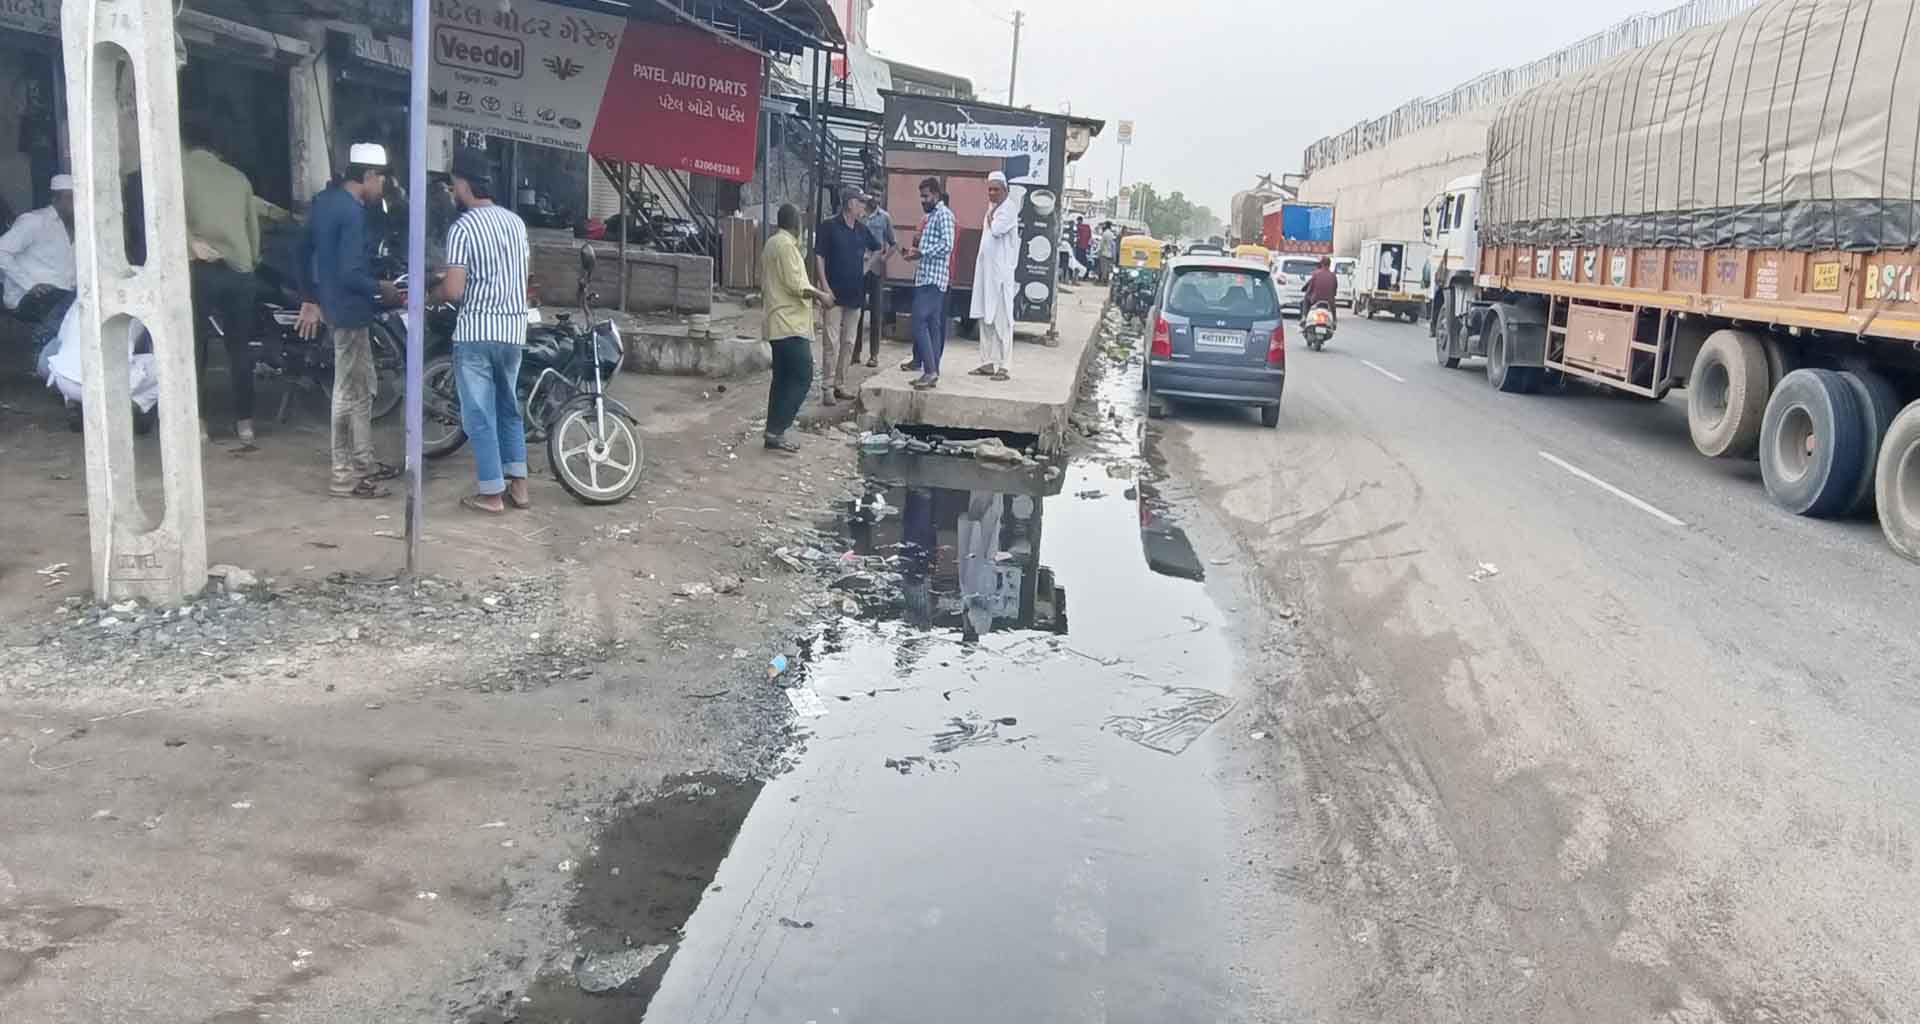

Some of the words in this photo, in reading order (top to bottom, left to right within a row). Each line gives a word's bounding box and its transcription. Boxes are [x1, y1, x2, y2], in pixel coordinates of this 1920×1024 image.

[439, 34, 520, 71] Veedol
[633, 63, 668, 82] PATEL
[672, 71, 706, 89] AUTO
[709, 78, 748, 97] PARTS
[658, 93, 684, 112] પટેલ
[687, 98, 713, 117] ઓટો
